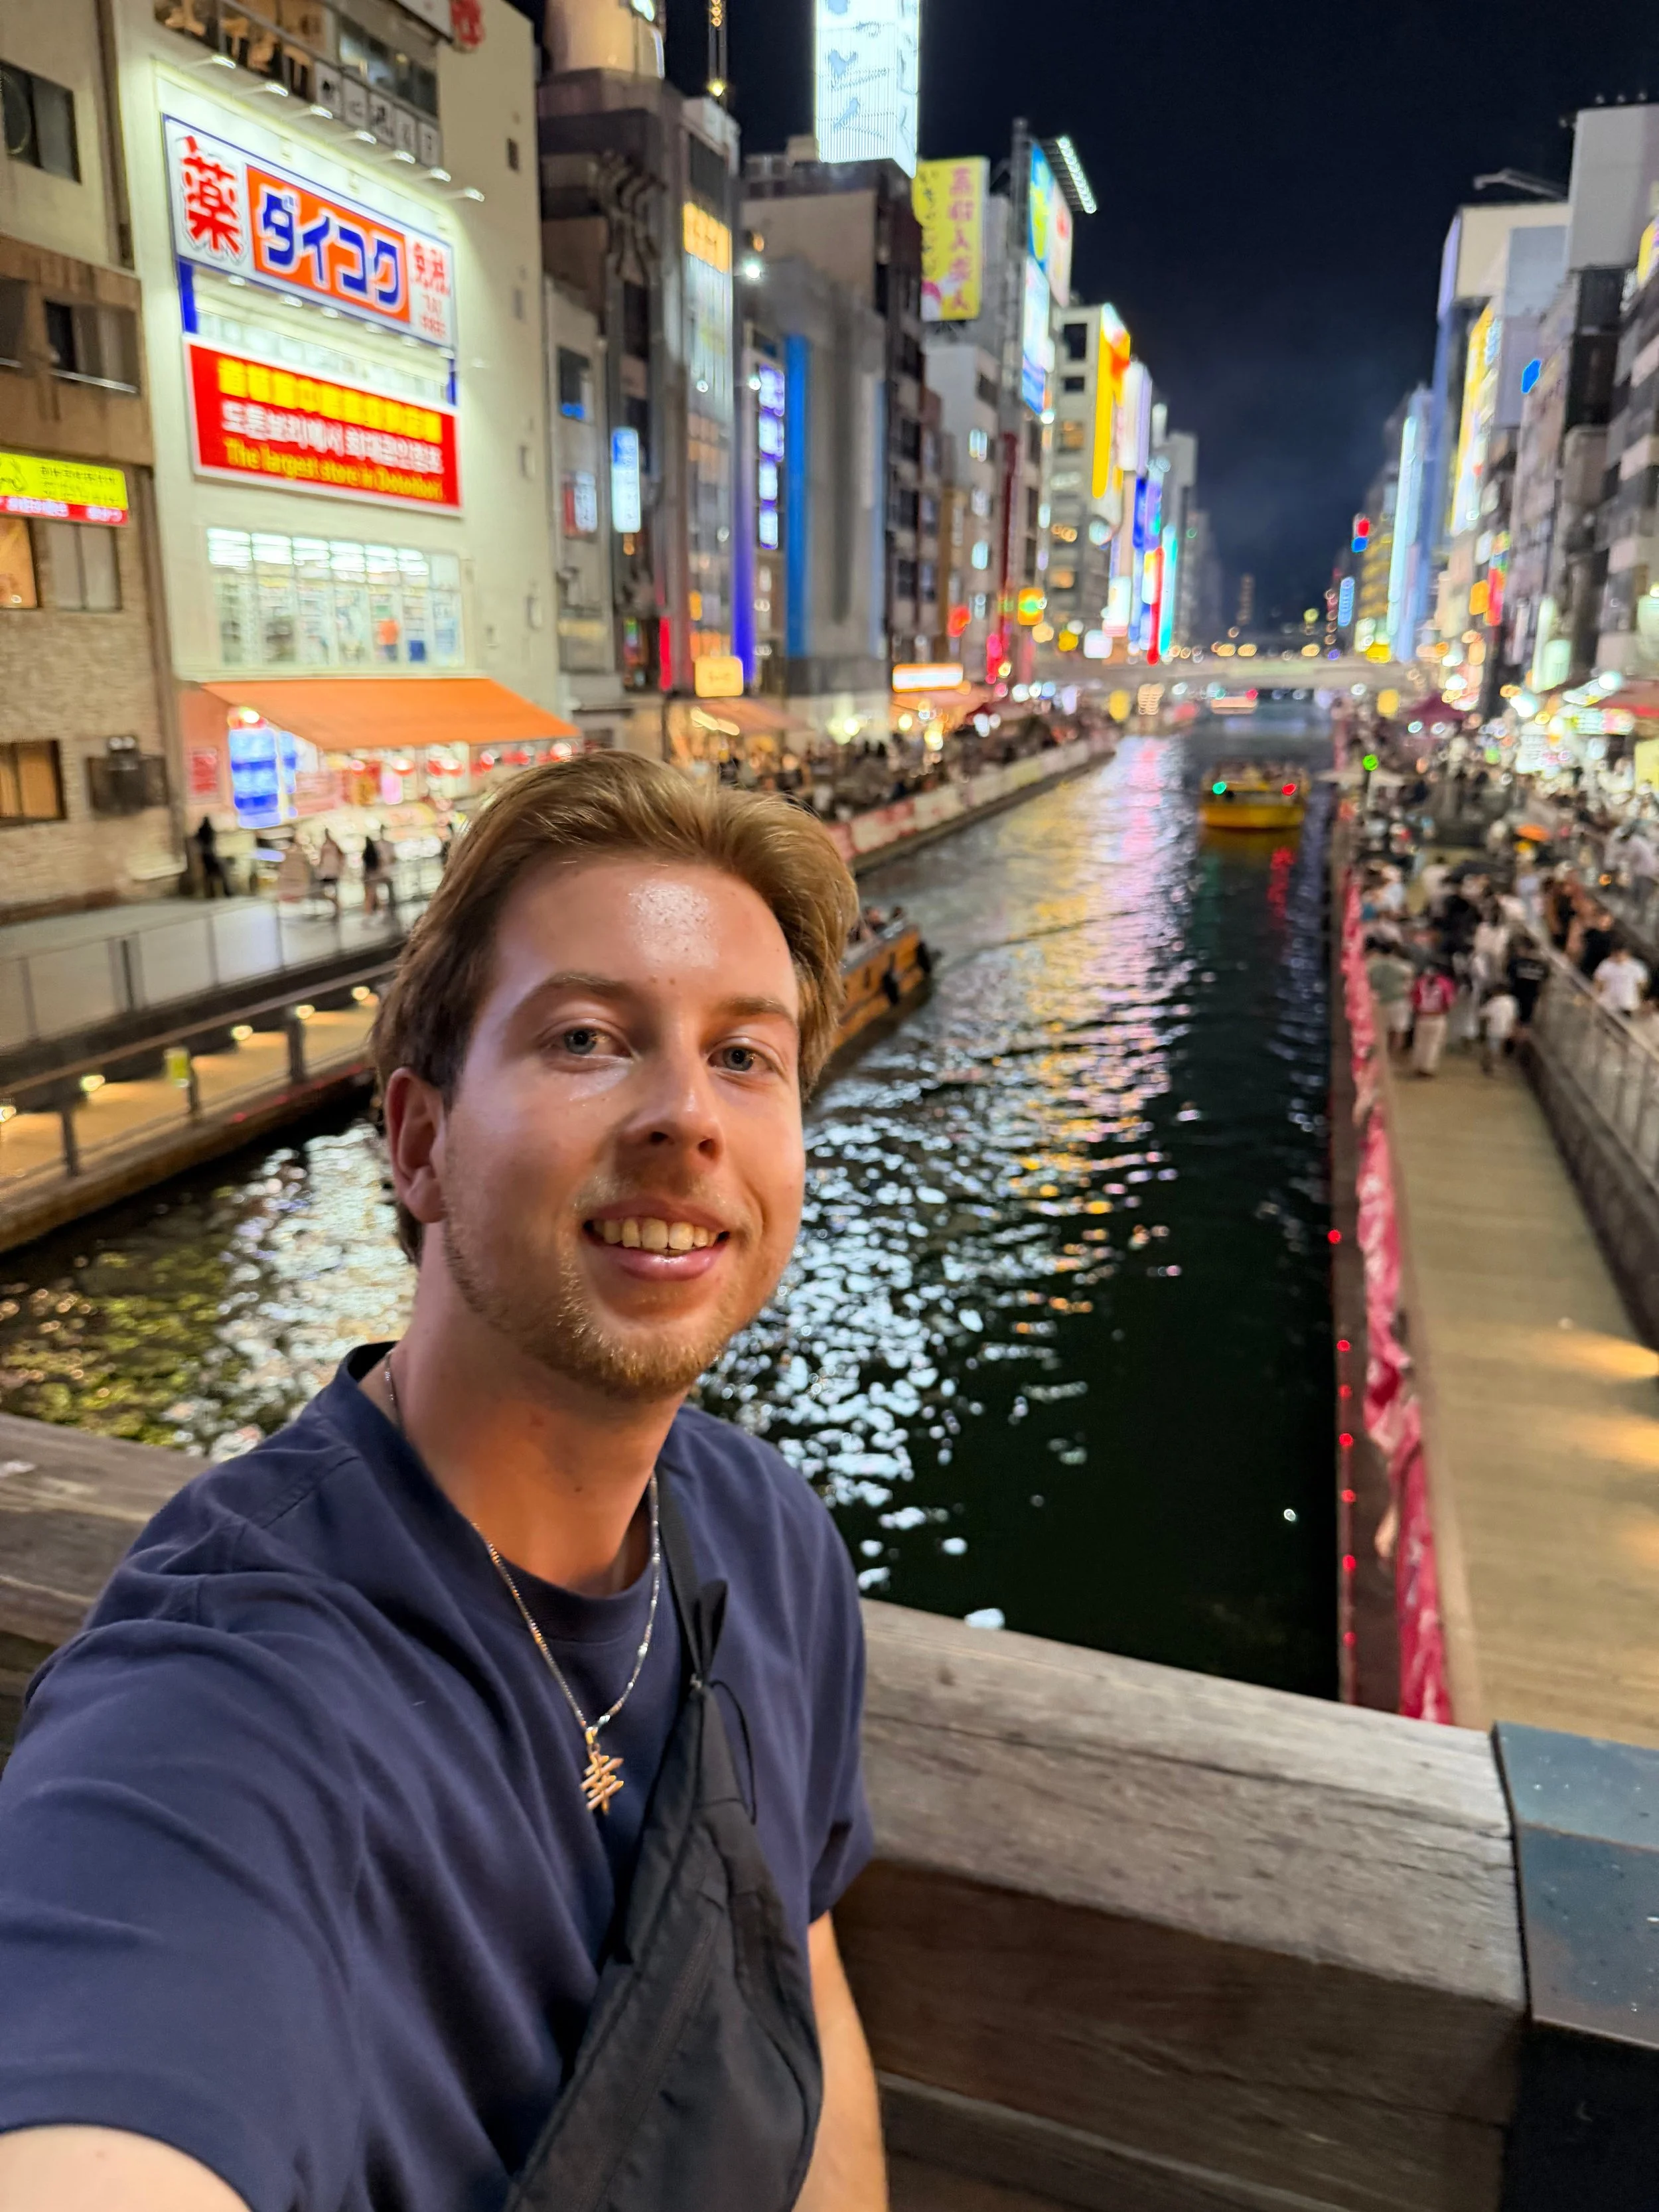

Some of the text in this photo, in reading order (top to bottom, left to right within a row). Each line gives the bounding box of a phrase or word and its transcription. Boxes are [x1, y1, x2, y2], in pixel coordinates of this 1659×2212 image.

[181, 135, 401, 307] 薬 ダイコク
[225, 437, 259, 467] The
[260, 442, 319, 480] largest
[321, 459, 359, 486] store
